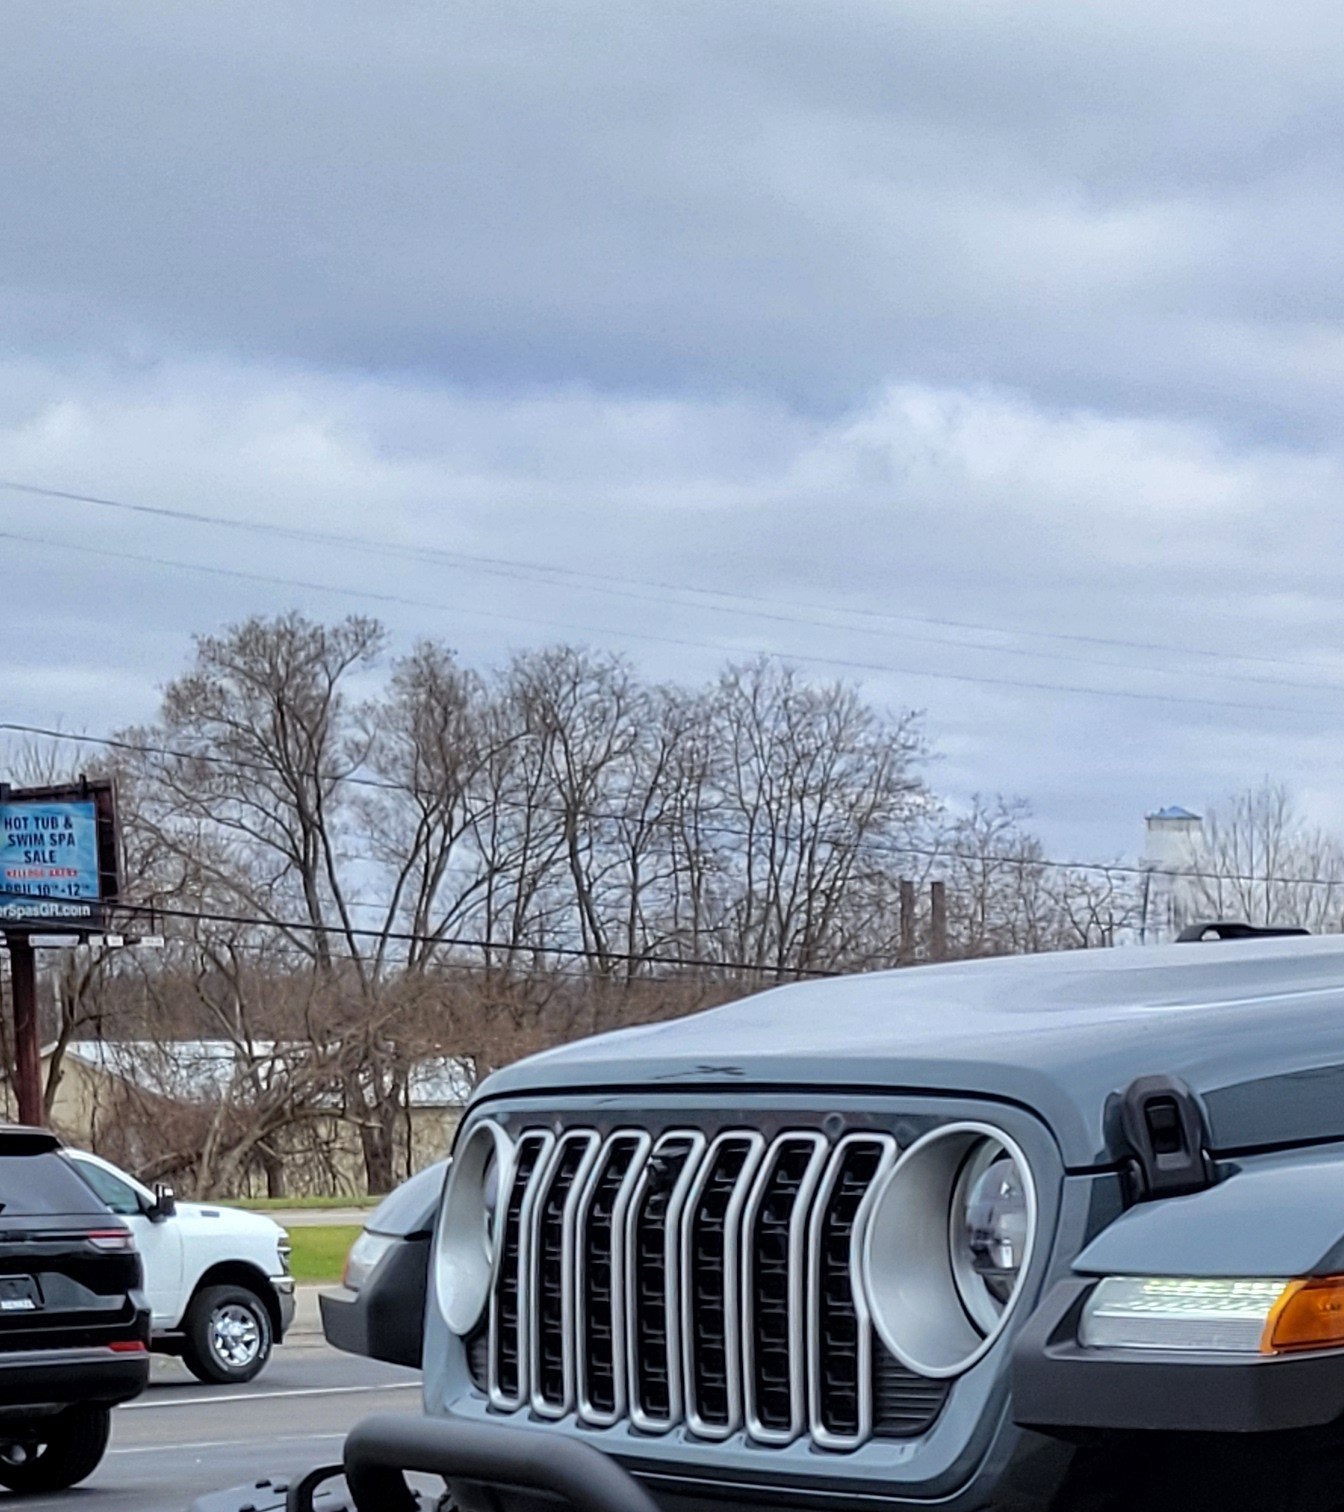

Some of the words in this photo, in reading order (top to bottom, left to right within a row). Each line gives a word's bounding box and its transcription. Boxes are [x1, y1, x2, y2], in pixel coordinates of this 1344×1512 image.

[4, 816, 28, 831] HOT
[34, 816, 59, 830] TUB
[63, 816, 73, 830] &
[8, 833, 45, 847] SWIM
[49, 833, 76, 847] SPA
[23, 850, 57, 864] SALE
